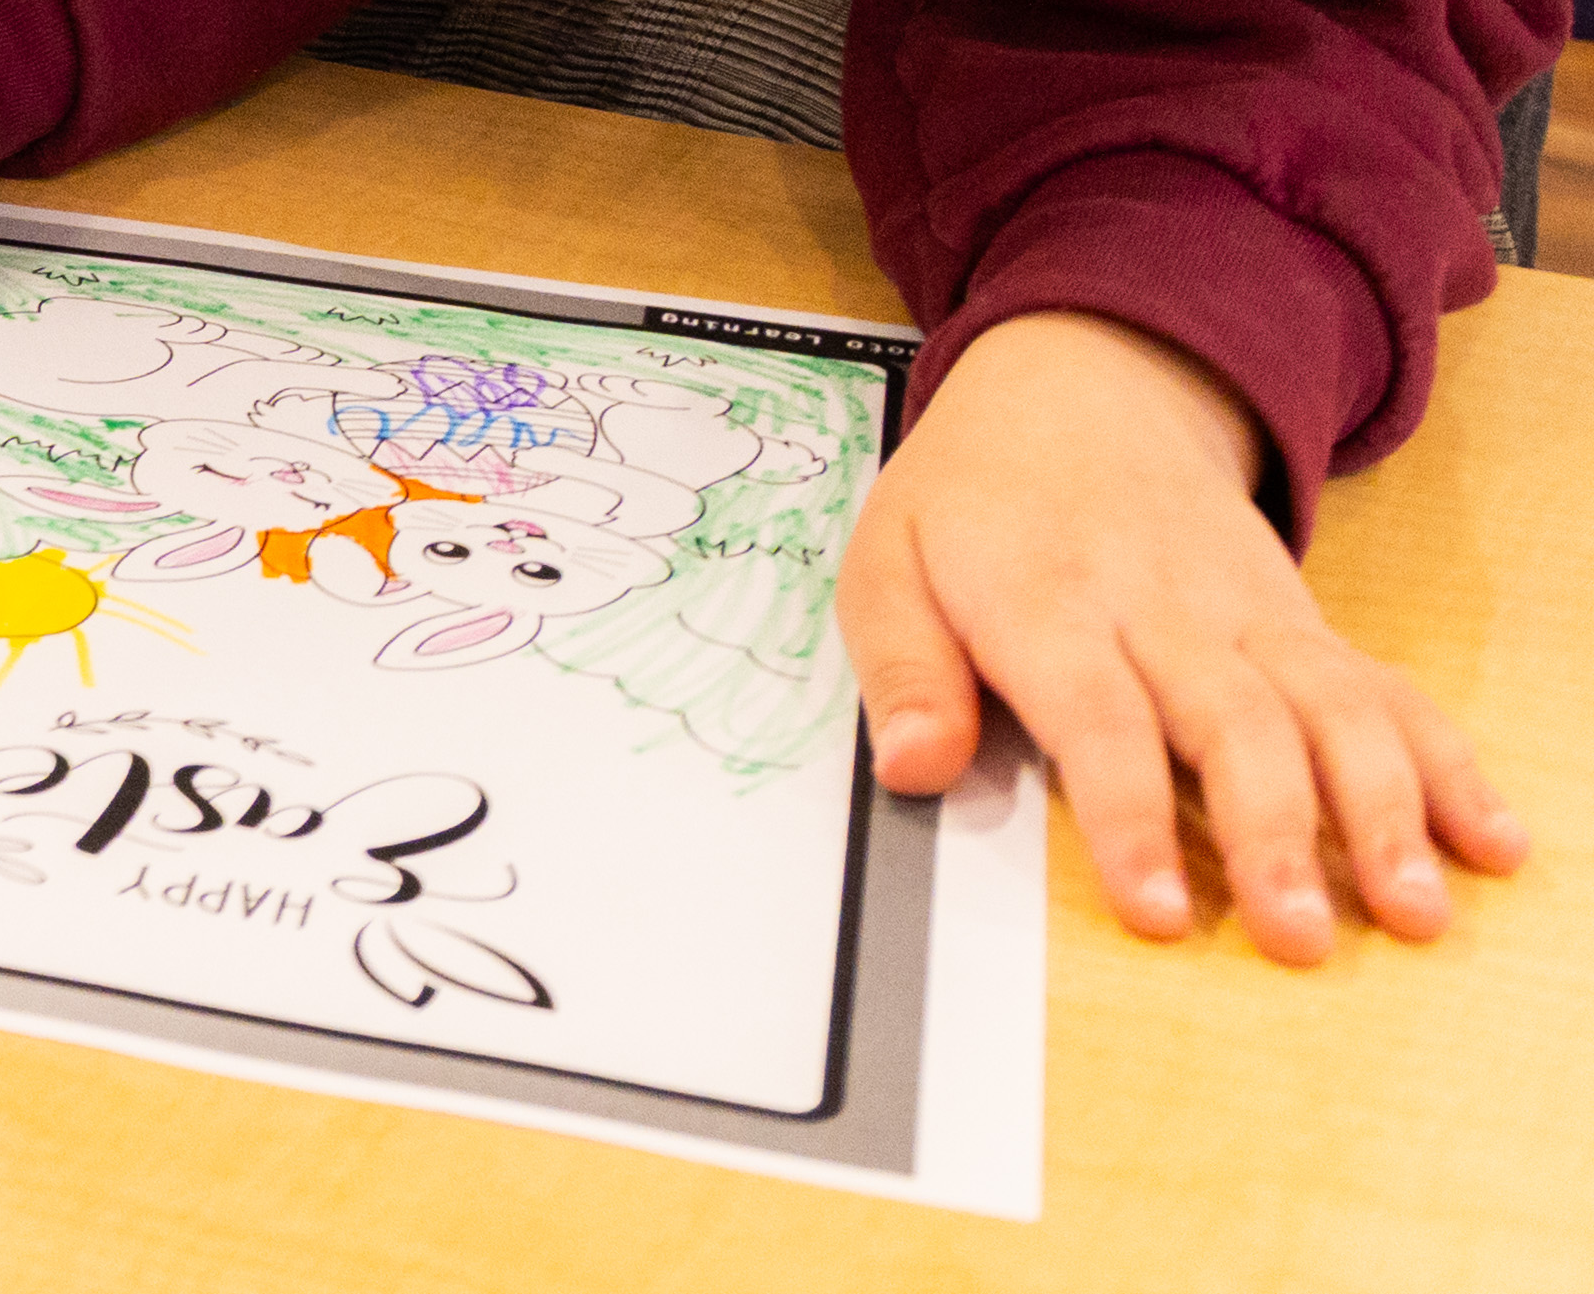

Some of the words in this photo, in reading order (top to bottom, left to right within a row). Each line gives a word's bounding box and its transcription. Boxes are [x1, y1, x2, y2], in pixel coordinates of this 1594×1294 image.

[660, 311, 822, 346] Learning
[845, 338, 917, 358] oto
[118, 863, 315, 928] HAPPY
